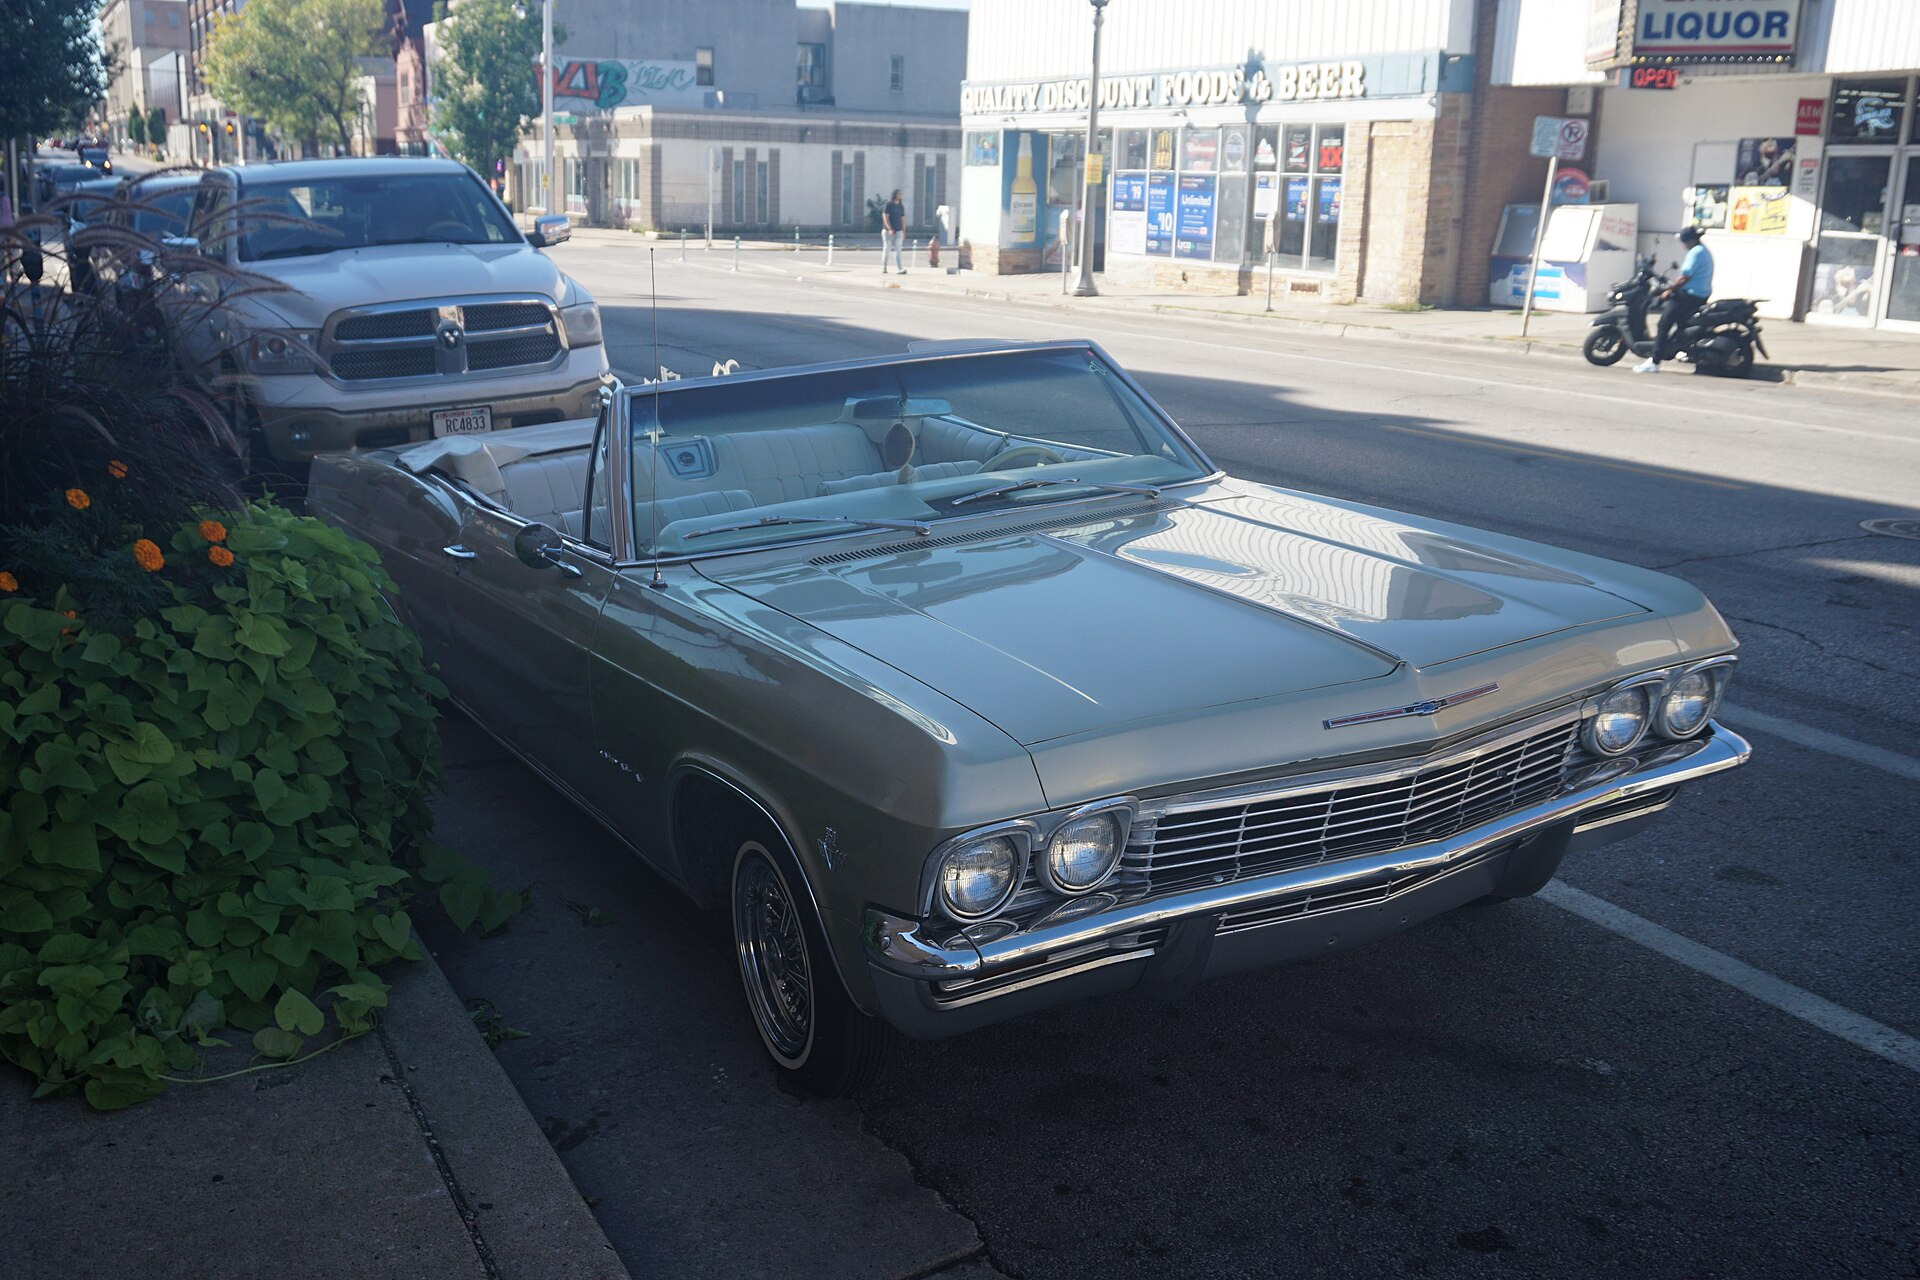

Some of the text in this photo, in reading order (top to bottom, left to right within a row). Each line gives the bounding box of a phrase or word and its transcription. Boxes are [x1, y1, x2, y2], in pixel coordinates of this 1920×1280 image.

[1642, 11, 1790, 39] LIQUOR
[963, 84, 1041, 114] QUALITY
[1159, 70, 1245, 105] FOODS
[1250, 70, 1272, 100] &
[1278, 60, 1366, 100] BEER
[1633, 68, 1679, 88] OPEN
[1798, 105, 1823, 119] ATM
[1182, 194, 1212, 206] Unlimited
[446, 415, 486, 433] RC4833
